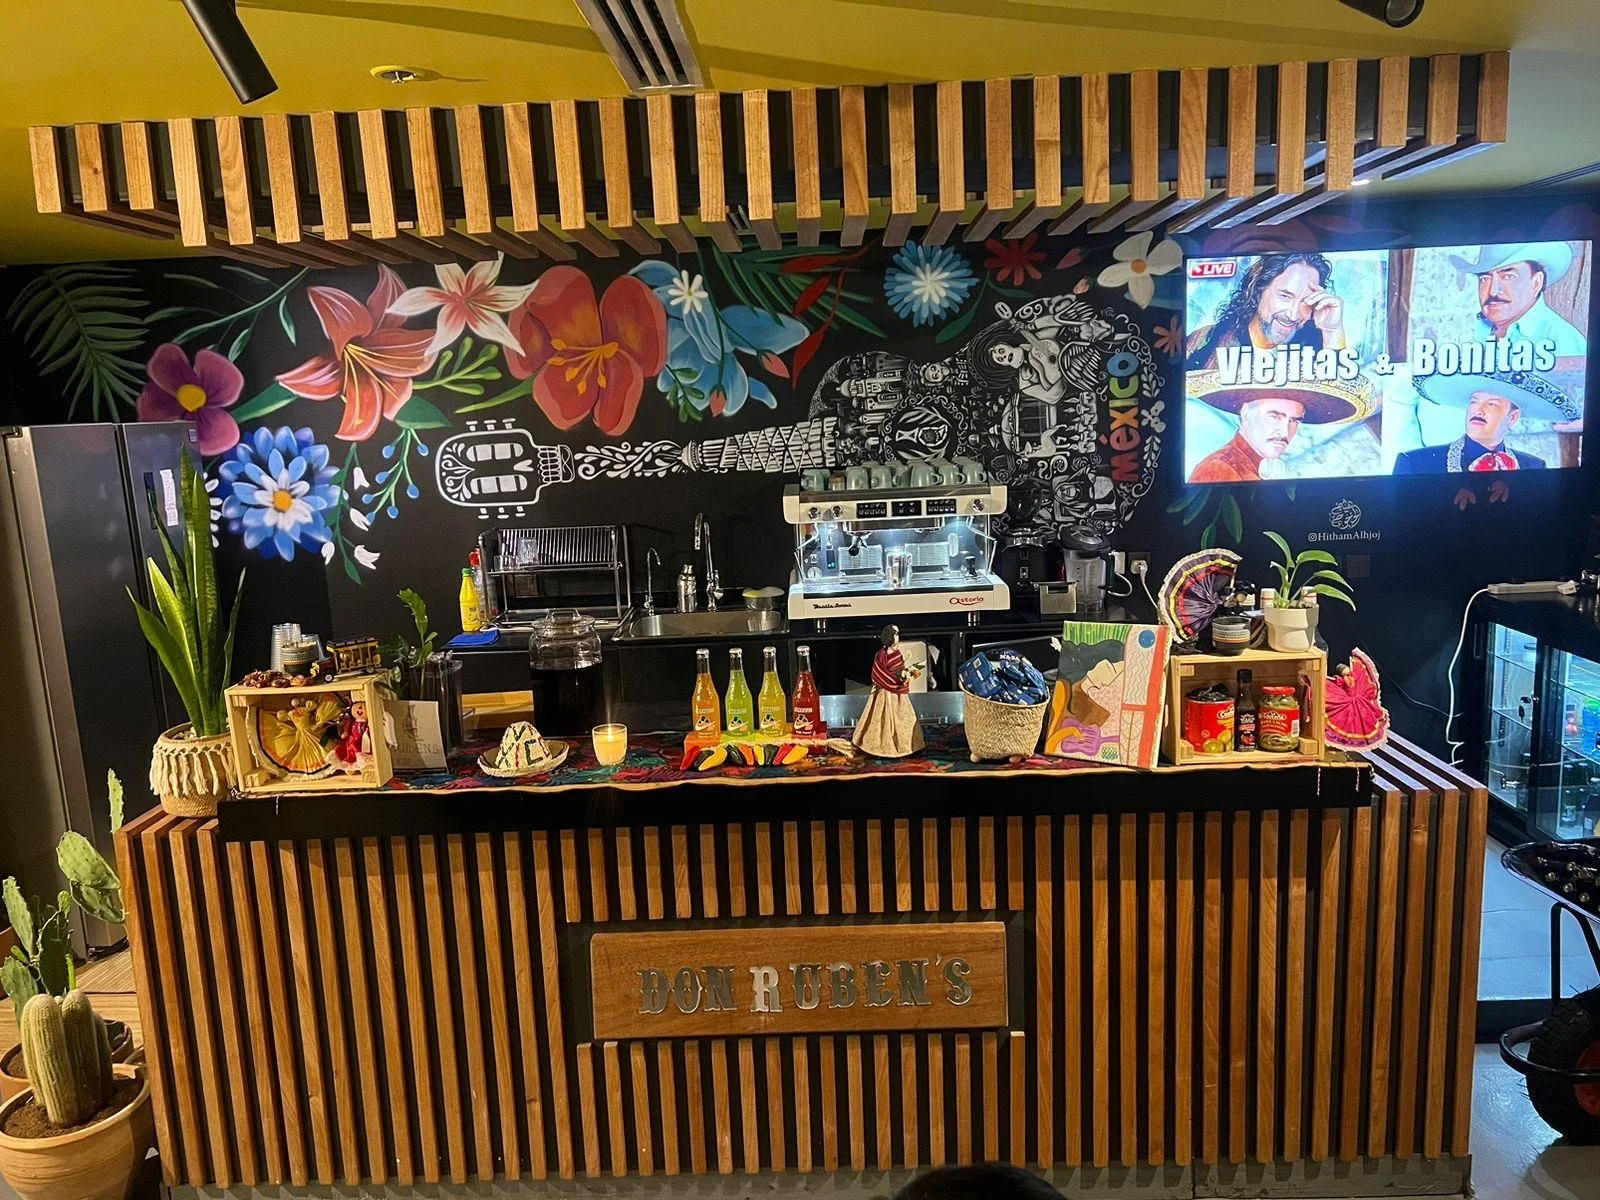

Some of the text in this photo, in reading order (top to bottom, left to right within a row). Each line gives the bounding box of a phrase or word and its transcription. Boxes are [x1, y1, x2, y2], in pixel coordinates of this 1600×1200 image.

[1203, 263, 1234, 275] LIVE
[1216, 334, 1556, 387] Viejitas & Bonitas
[636, 954, 973, 1014] DON RUBEN'S
